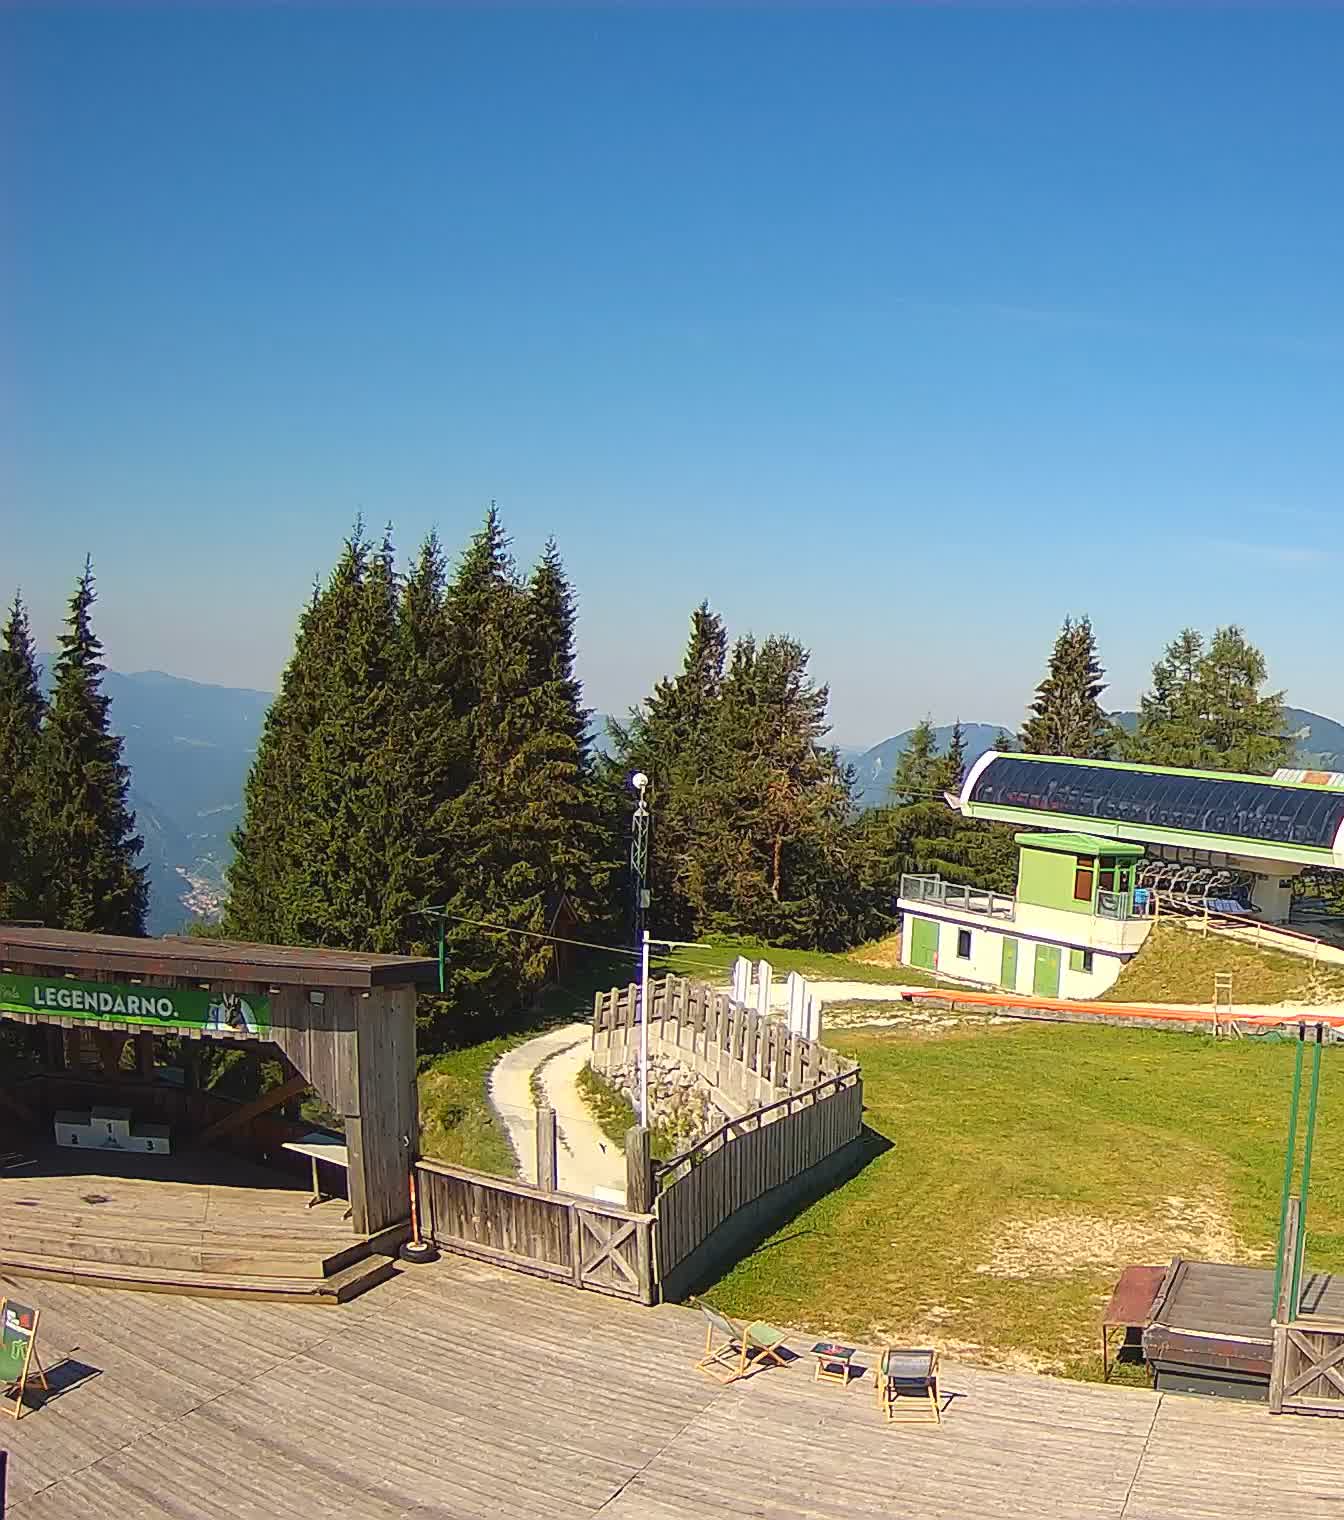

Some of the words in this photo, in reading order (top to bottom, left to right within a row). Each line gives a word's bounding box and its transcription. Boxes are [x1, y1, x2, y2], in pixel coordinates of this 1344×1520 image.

[34, 986, 179, 1017] LEGENDARNO.
[71, 1133, 79, 1145] 2
[145, 1140, 154, 1151] 3
